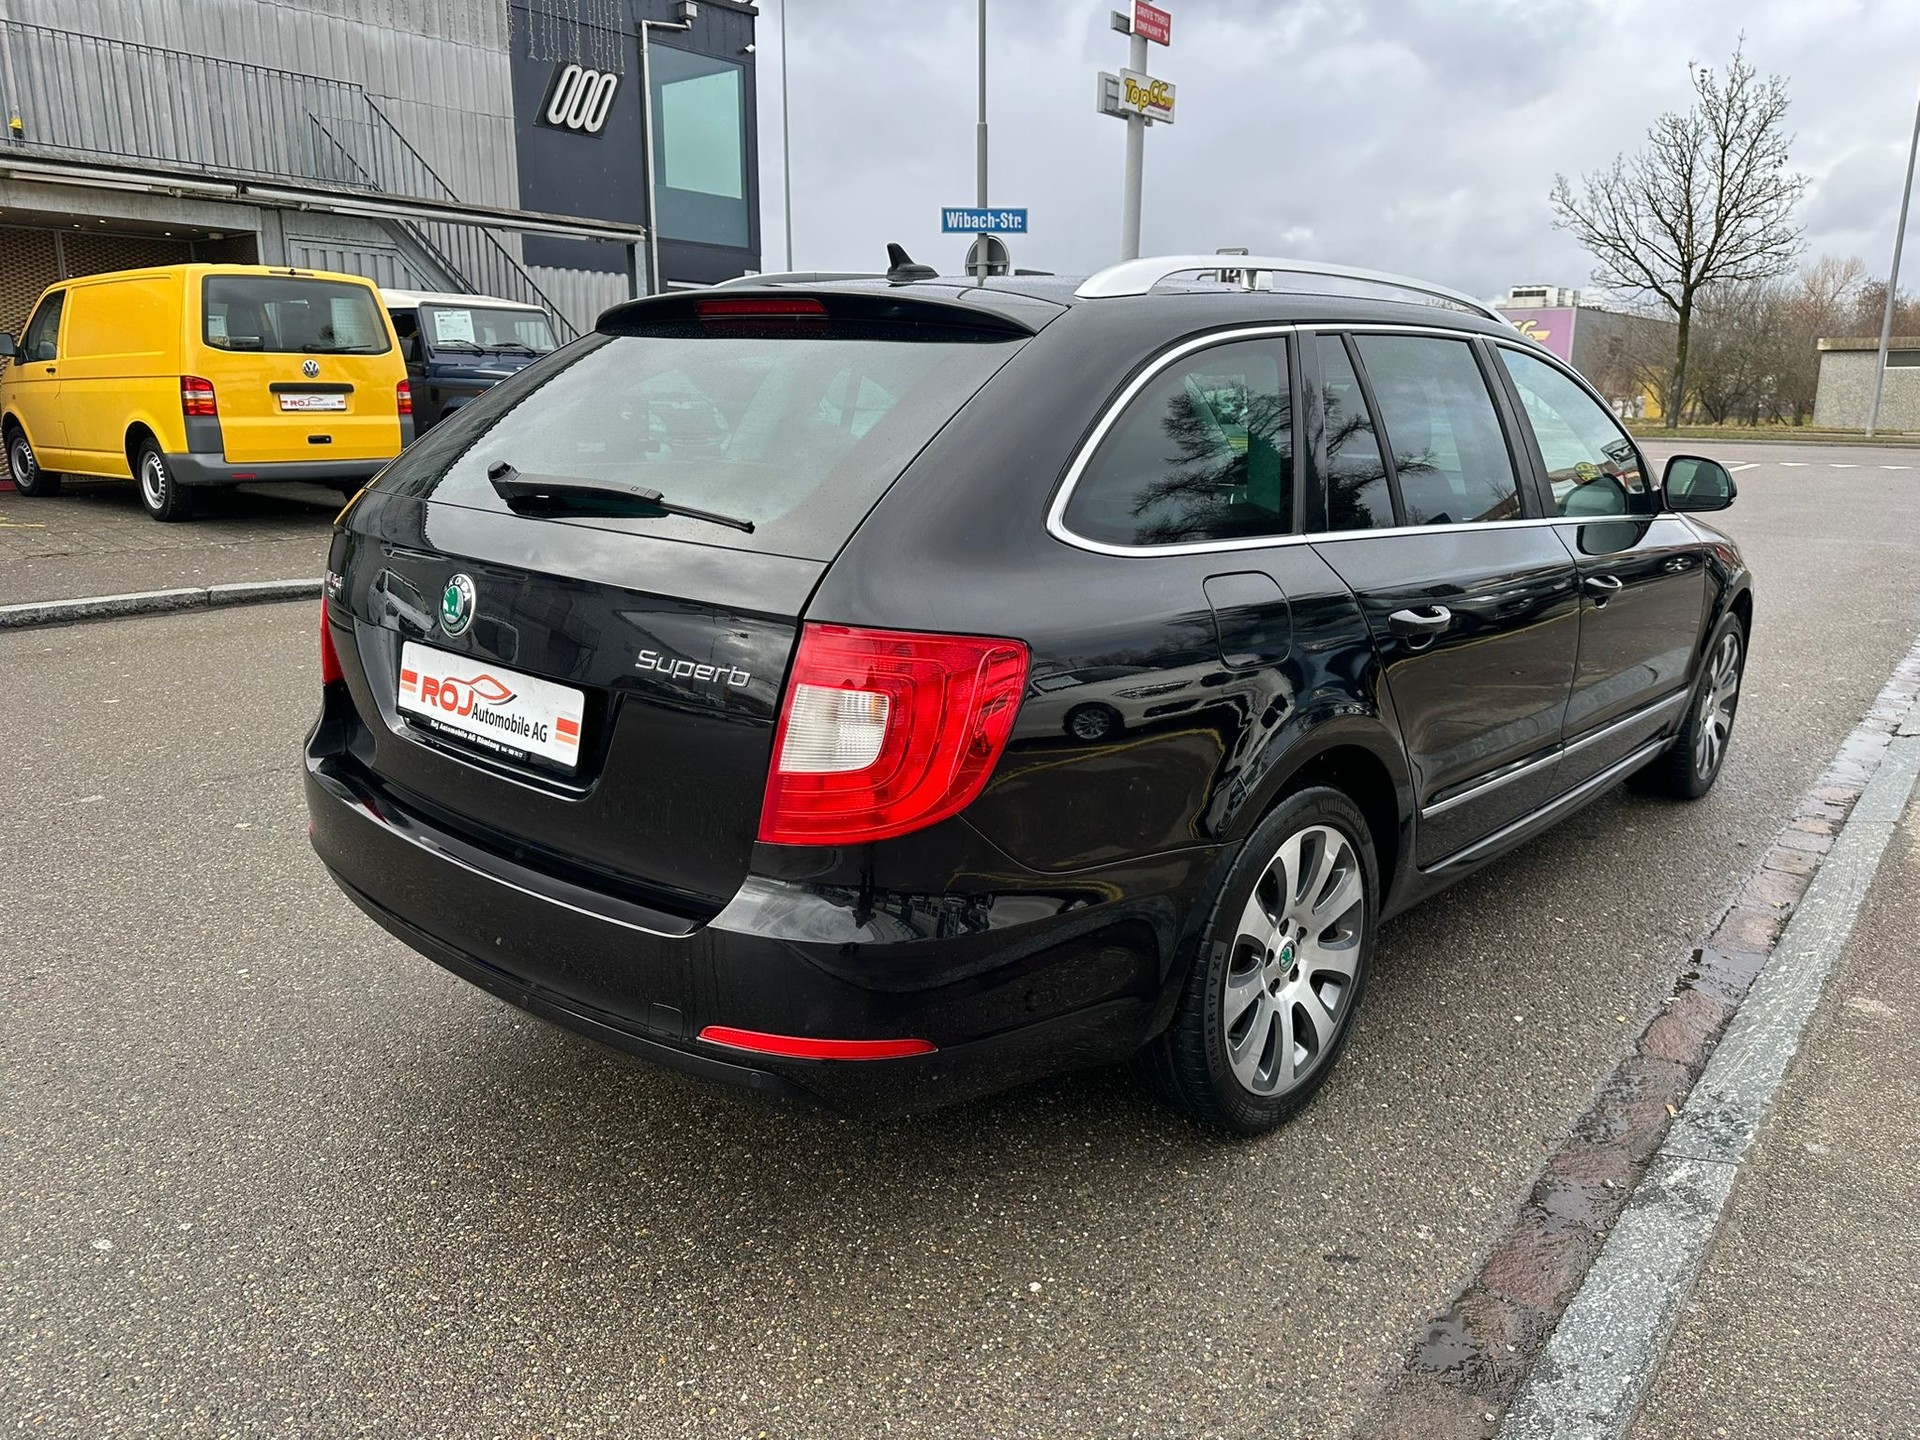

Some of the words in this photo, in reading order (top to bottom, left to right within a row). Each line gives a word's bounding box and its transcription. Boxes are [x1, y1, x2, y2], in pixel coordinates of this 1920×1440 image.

[1124, 78, 1169, 112] TopCC
[946, 211, 1022, 229] Wibach-Str.
[635, 649, 751, 687] Superb
[421, 675, 475, 716] ROJ
[471, 703, 530, 737] Automobile
[531, 721, 548, 743] AG
[439, 722, 468, 738] Automobile
[1211, 951, 1223, 971] XL
[1208, 993, 1217, 1009] 17
[1207, 1012, 1216, 1022] R
[1207, 1026, 1219, 1072] 225/45
